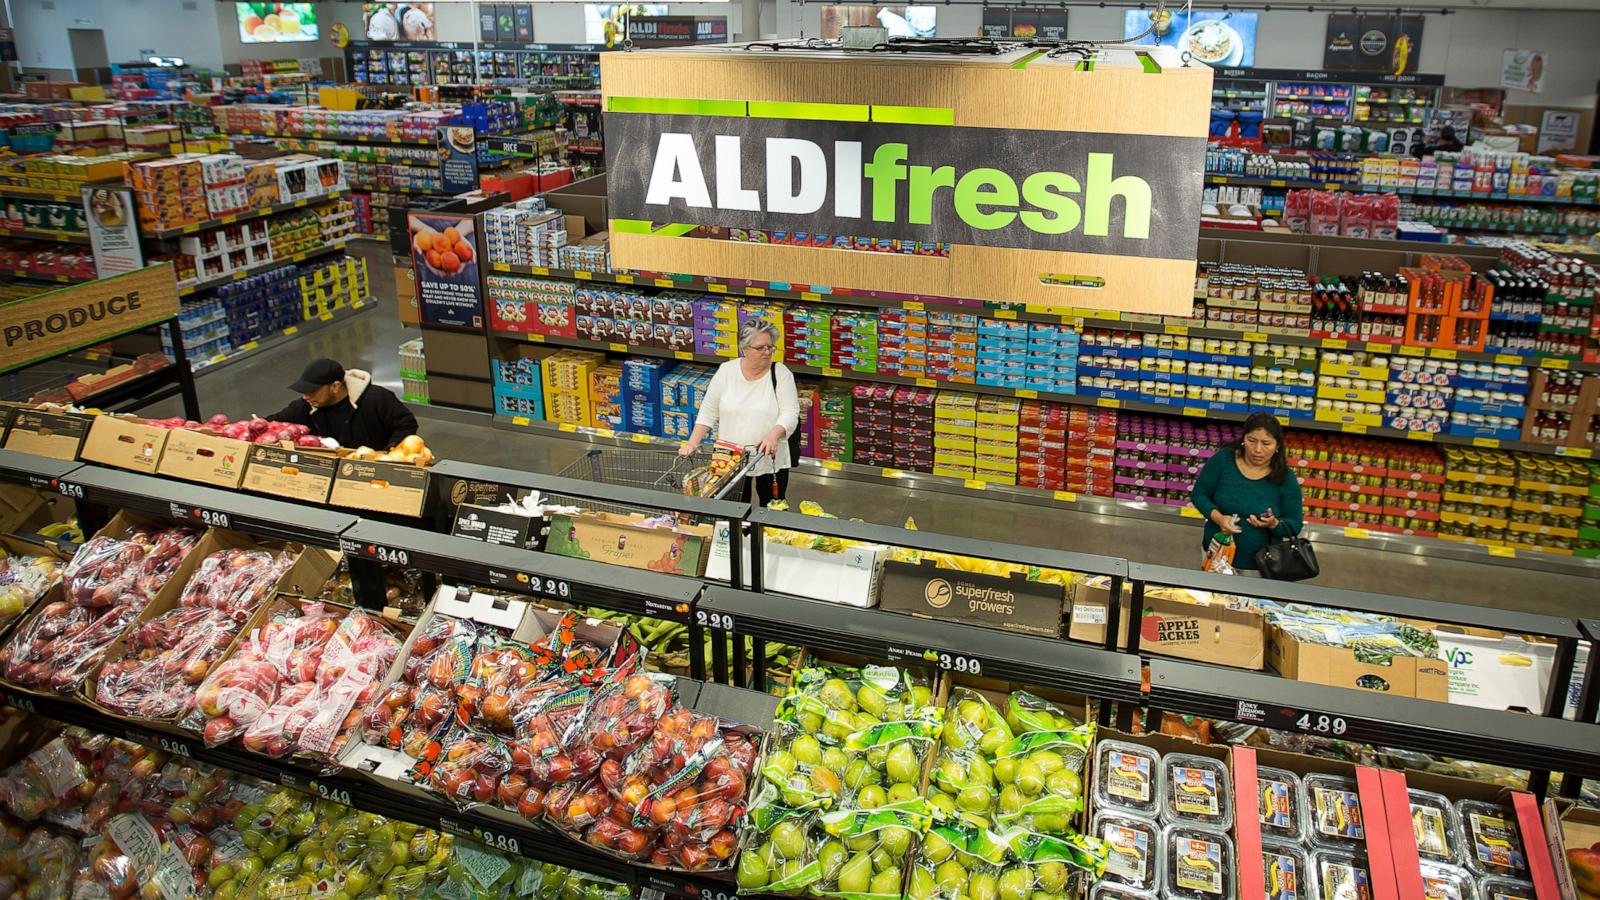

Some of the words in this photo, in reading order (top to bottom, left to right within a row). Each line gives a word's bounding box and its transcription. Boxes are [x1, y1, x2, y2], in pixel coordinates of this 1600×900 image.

[503, 142, 518, 152] RICE
[645, 132, 1153, 240] ALDIfresh
[421, 281, 438, 289] SAVE
[3, 290, 142, 347] PRODUCE
[602, 544, 634, 559] Grapes
[531, 577, 568, 596] 2.29
[956, 585, 1014, 603] superfresh
[969, 600, 1014, 614] growers
[696, 611, 733, 629] 2.29
[1158, 620, 1199, 631] APPLE
[1159, 630, 1200, 641] ACRES
[940, 654, 980, 674] 3.99
[1445, 647, 1473, 668] vpc
[1296, 714, 1347, 735] 4.89
